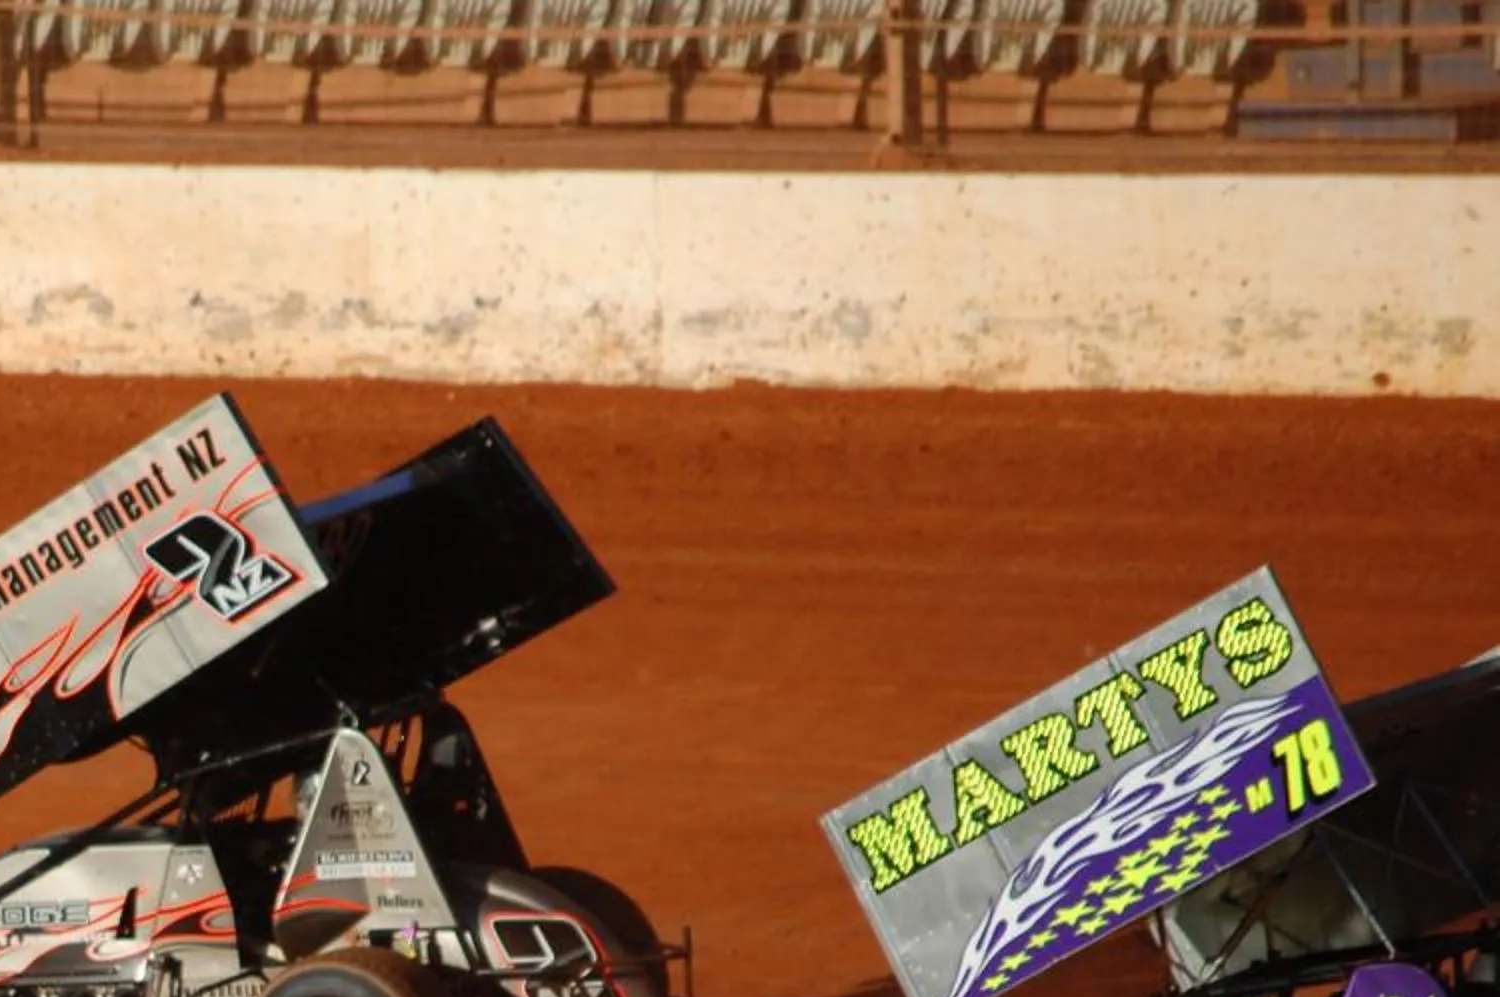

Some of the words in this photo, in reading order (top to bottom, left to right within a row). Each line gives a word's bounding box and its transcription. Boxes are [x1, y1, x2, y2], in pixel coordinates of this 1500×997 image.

[176, 428, 227, 481] NZ
[212, 555, 274, 614] NZ
[848, 596, 1293, 895] MARTYS
